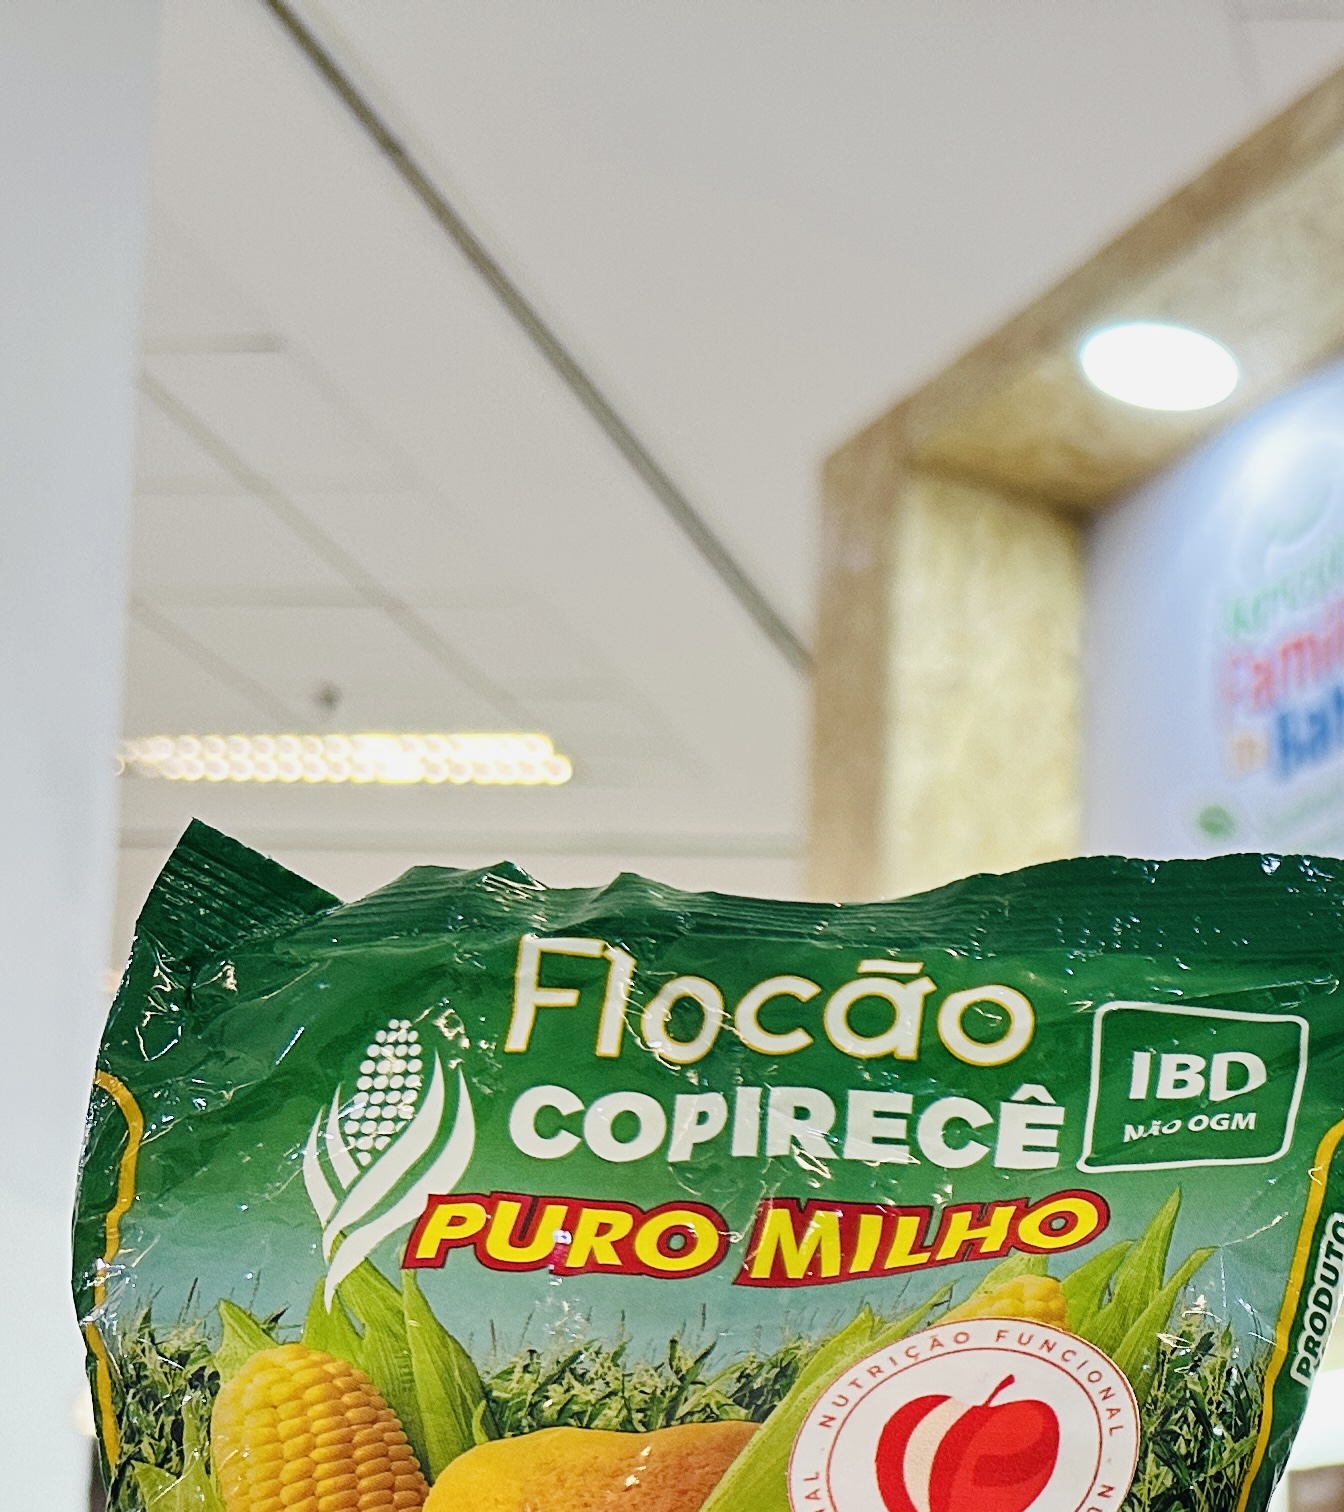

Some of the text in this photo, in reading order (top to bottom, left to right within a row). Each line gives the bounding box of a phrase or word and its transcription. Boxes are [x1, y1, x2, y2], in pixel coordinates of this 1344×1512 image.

[504, 934, 1036, 1067] Flocão
[1127, 1051, 1268, 1102] IBD
[509, 1084, 1066, 1171] COPIRECÊ
[1123, 1111, 1257, 1144] NÃO OGM
[412, 1198, 1099, 1280] PURO MILHO
[818, 1328, 1125, 1438] NUTRIÇÃO FUNCIONAL
